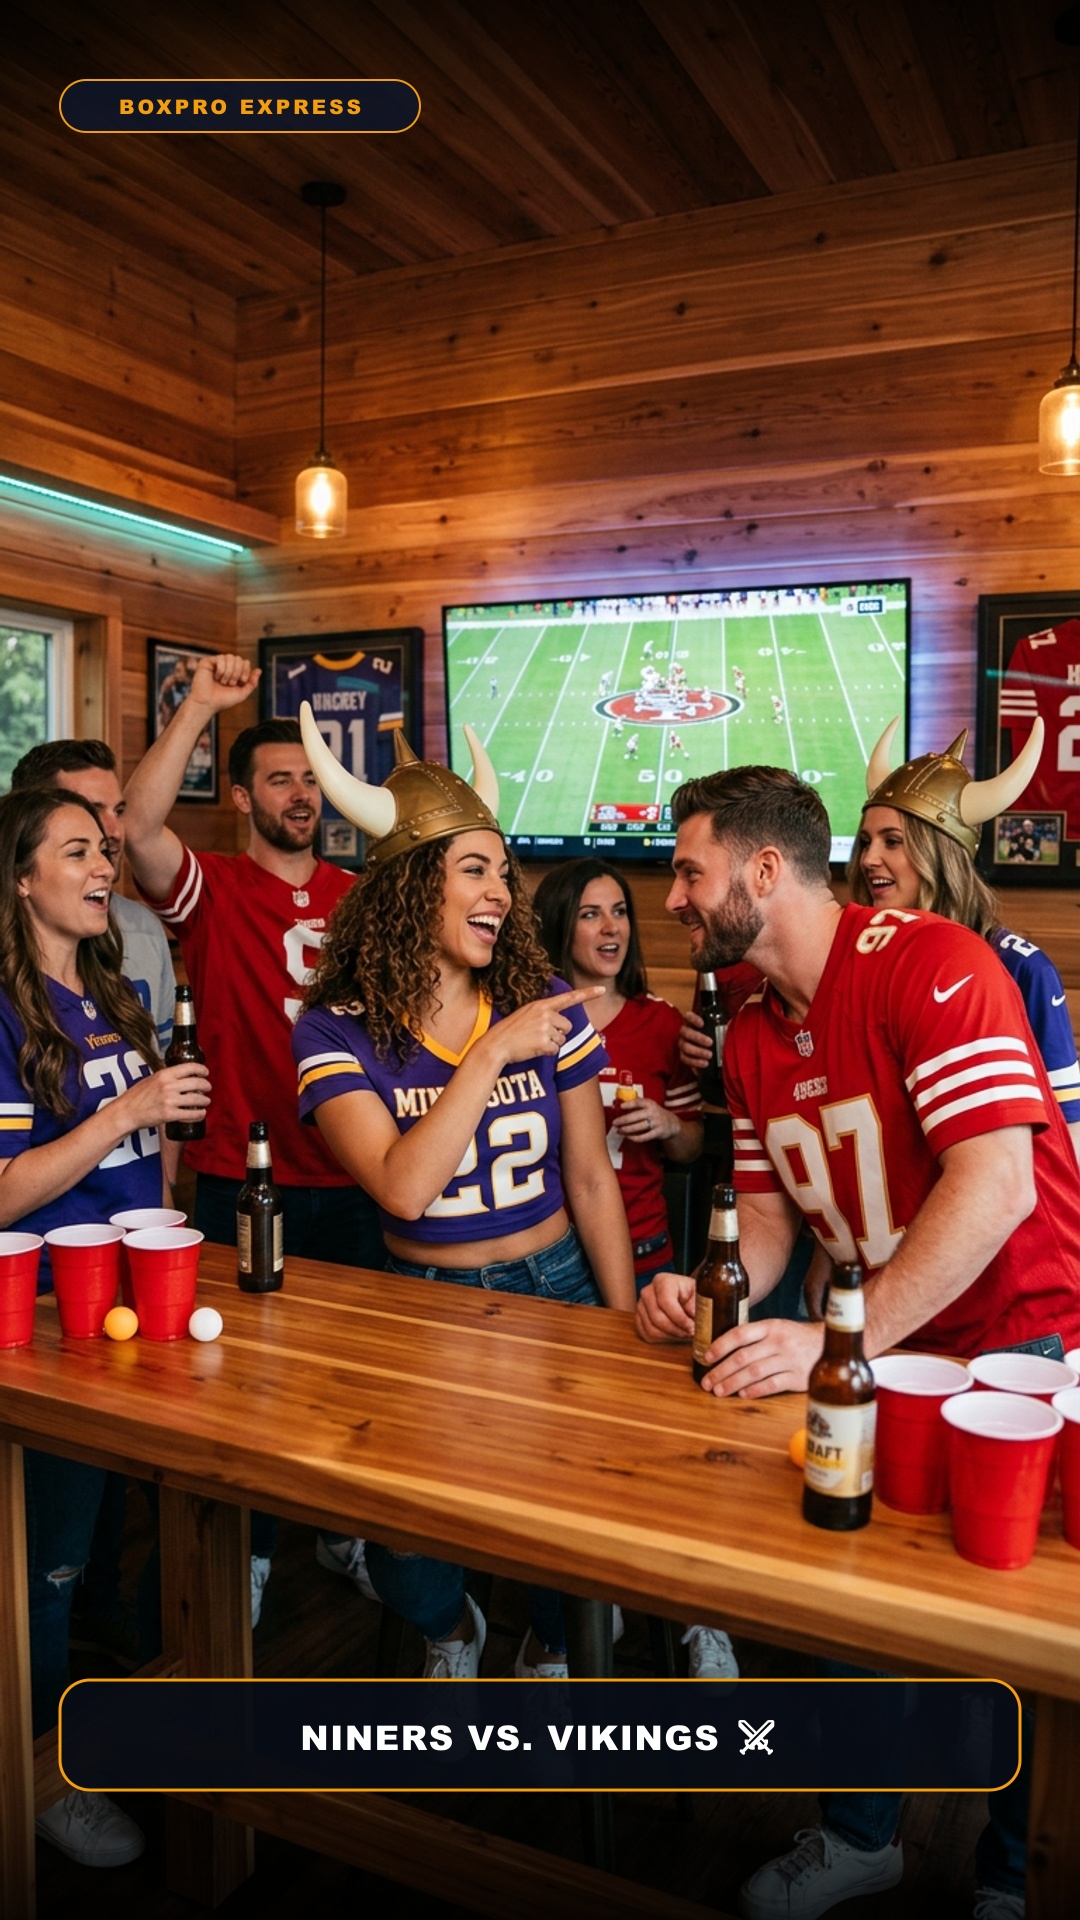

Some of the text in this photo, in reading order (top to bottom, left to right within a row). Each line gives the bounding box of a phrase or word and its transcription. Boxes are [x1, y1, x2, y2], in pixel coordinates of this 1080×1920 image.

[856, 909, 921, 954] 97
[423, 1111, 549, 1217] 22
[765, 1093, 907, 1269] 97
